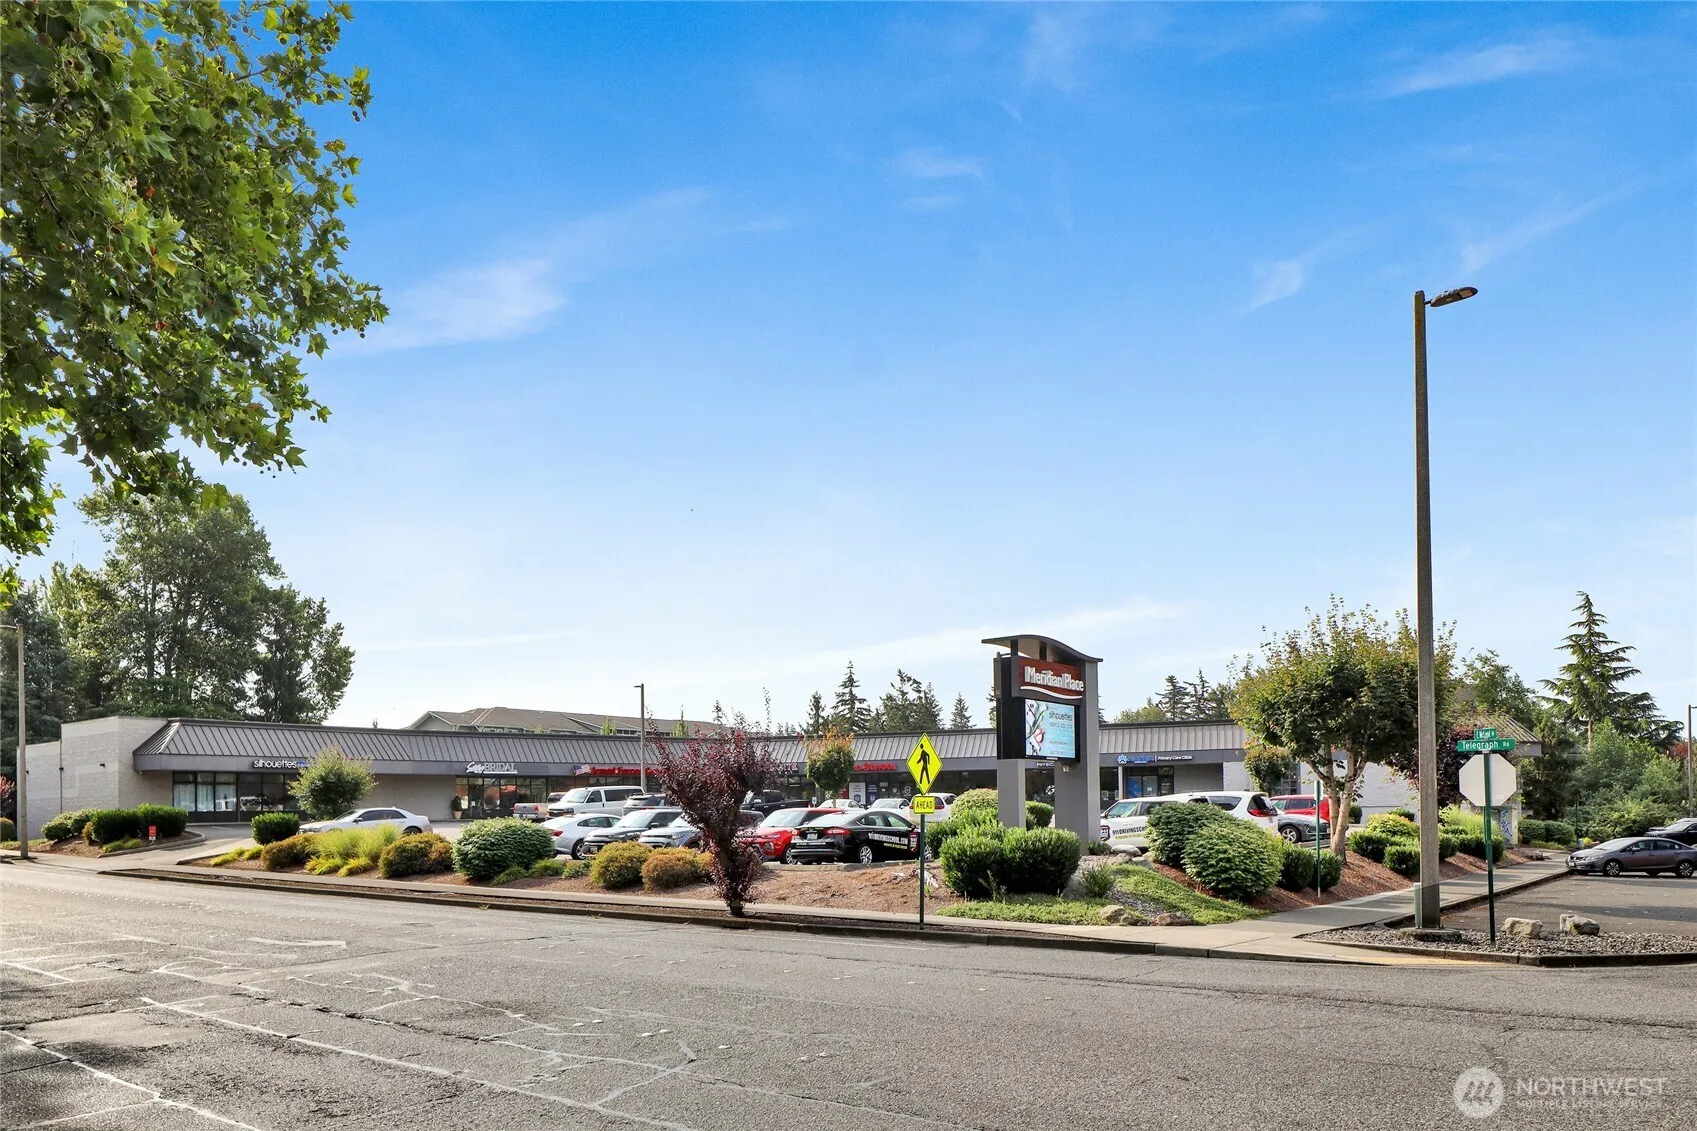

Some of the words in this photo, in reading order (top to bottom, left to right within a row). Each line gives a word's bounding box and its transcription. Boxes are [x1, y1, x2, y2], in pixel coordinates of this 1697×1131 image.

[1025, 666, 1062, 687] Meridian
[1062, 673, 1084, 691] Place
[1462, 741, 1499, 750] Telegraph
[484, 762, 517, 771] BRIDAL
[916, 800, 933, 809] AHEAD
